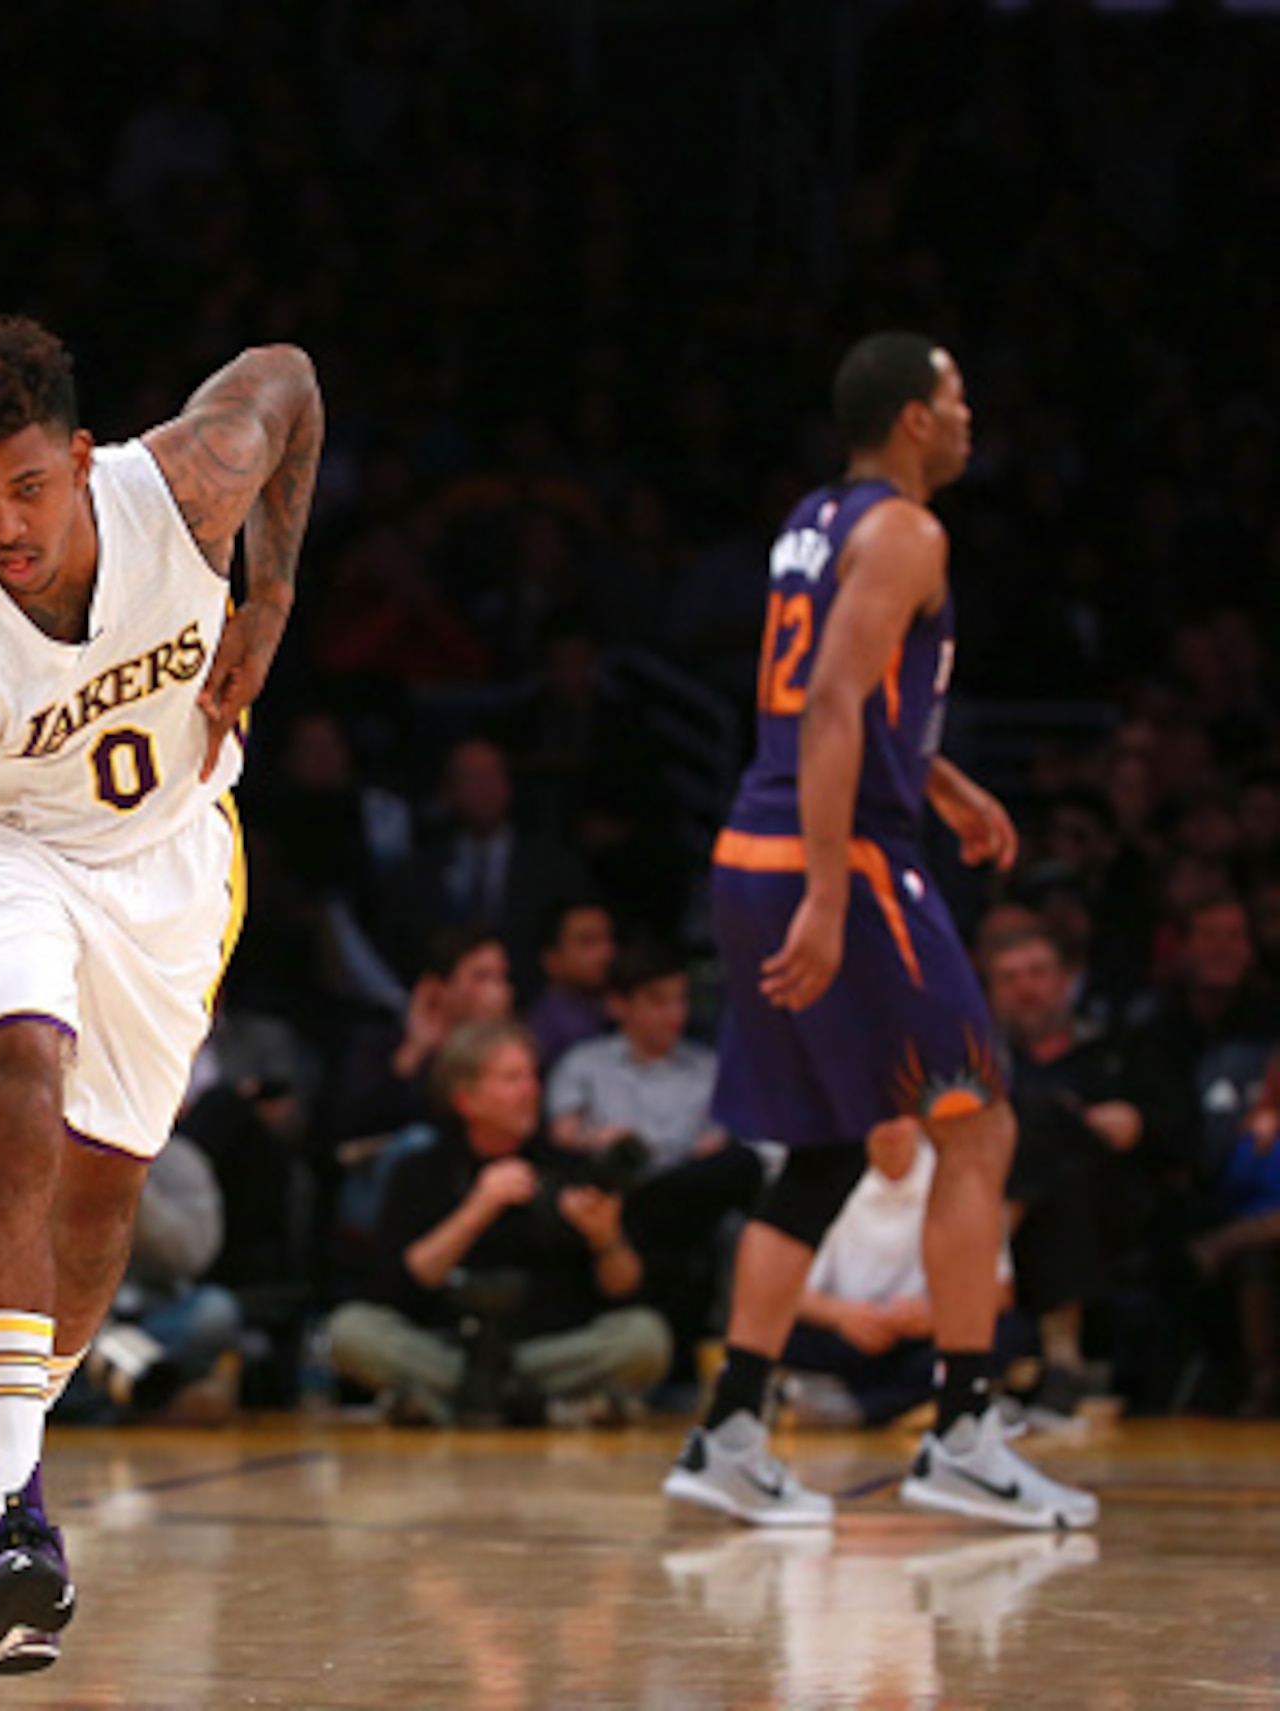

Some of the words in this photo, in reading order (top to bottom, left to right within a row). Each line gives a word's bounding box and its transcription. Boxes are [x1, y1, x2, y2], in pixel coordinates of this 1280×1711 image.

[18, 619, 207, 758] LAKERS
[756, 589, 813, 716] 12
[88, 725, 162, 814] 0
